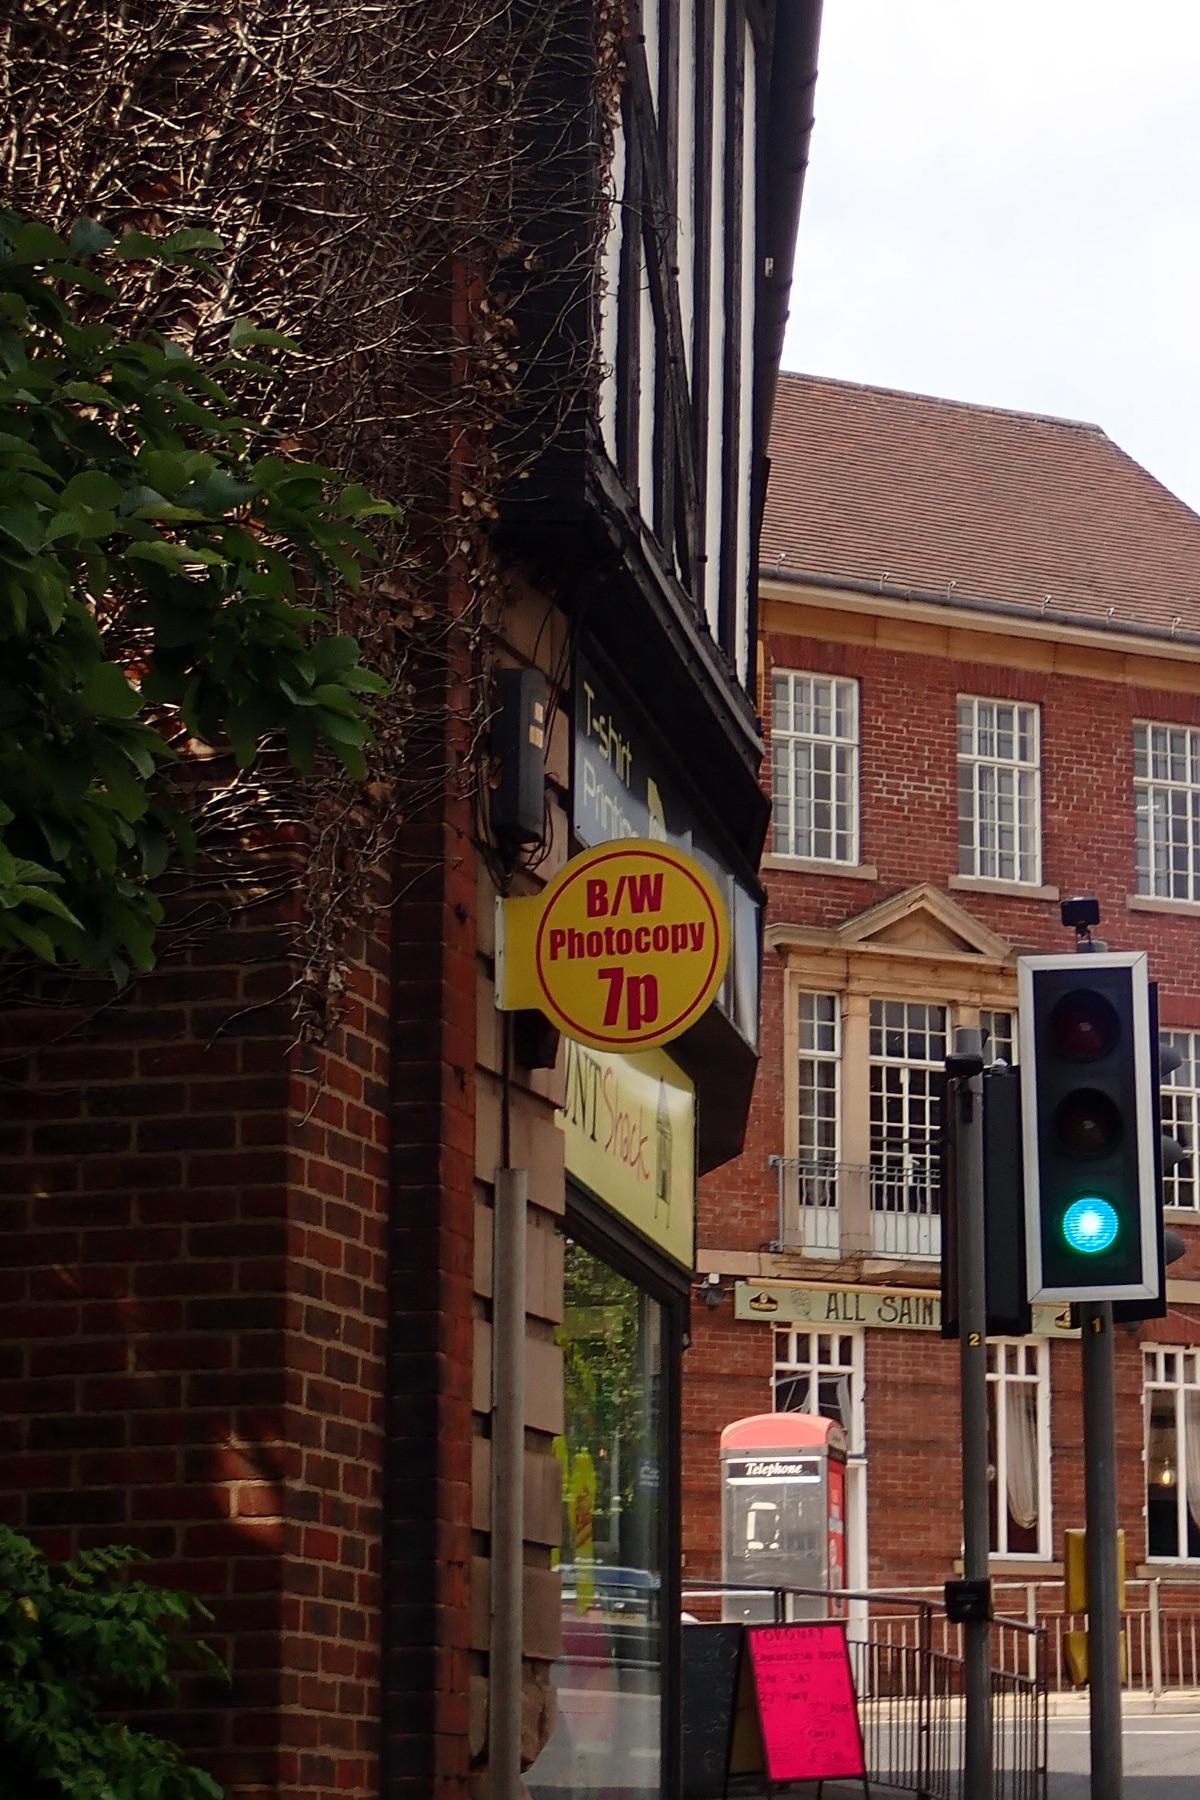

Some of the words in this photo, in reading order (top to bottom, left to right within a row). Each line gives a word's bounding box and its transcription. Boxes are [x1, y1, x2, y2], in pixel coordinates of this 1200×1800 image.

[586, 873, 664, 918] B/W
[549, 921, 705, 961] Photocopy
[598, 967, 659, 1031] 7p
[825, 1292, 866, 1322] ALL
[968, 1333, 981, 1347] 2
[1091, 1317, 1102, 1333] 1
[745, 1462, 803, 1477] Telephone
